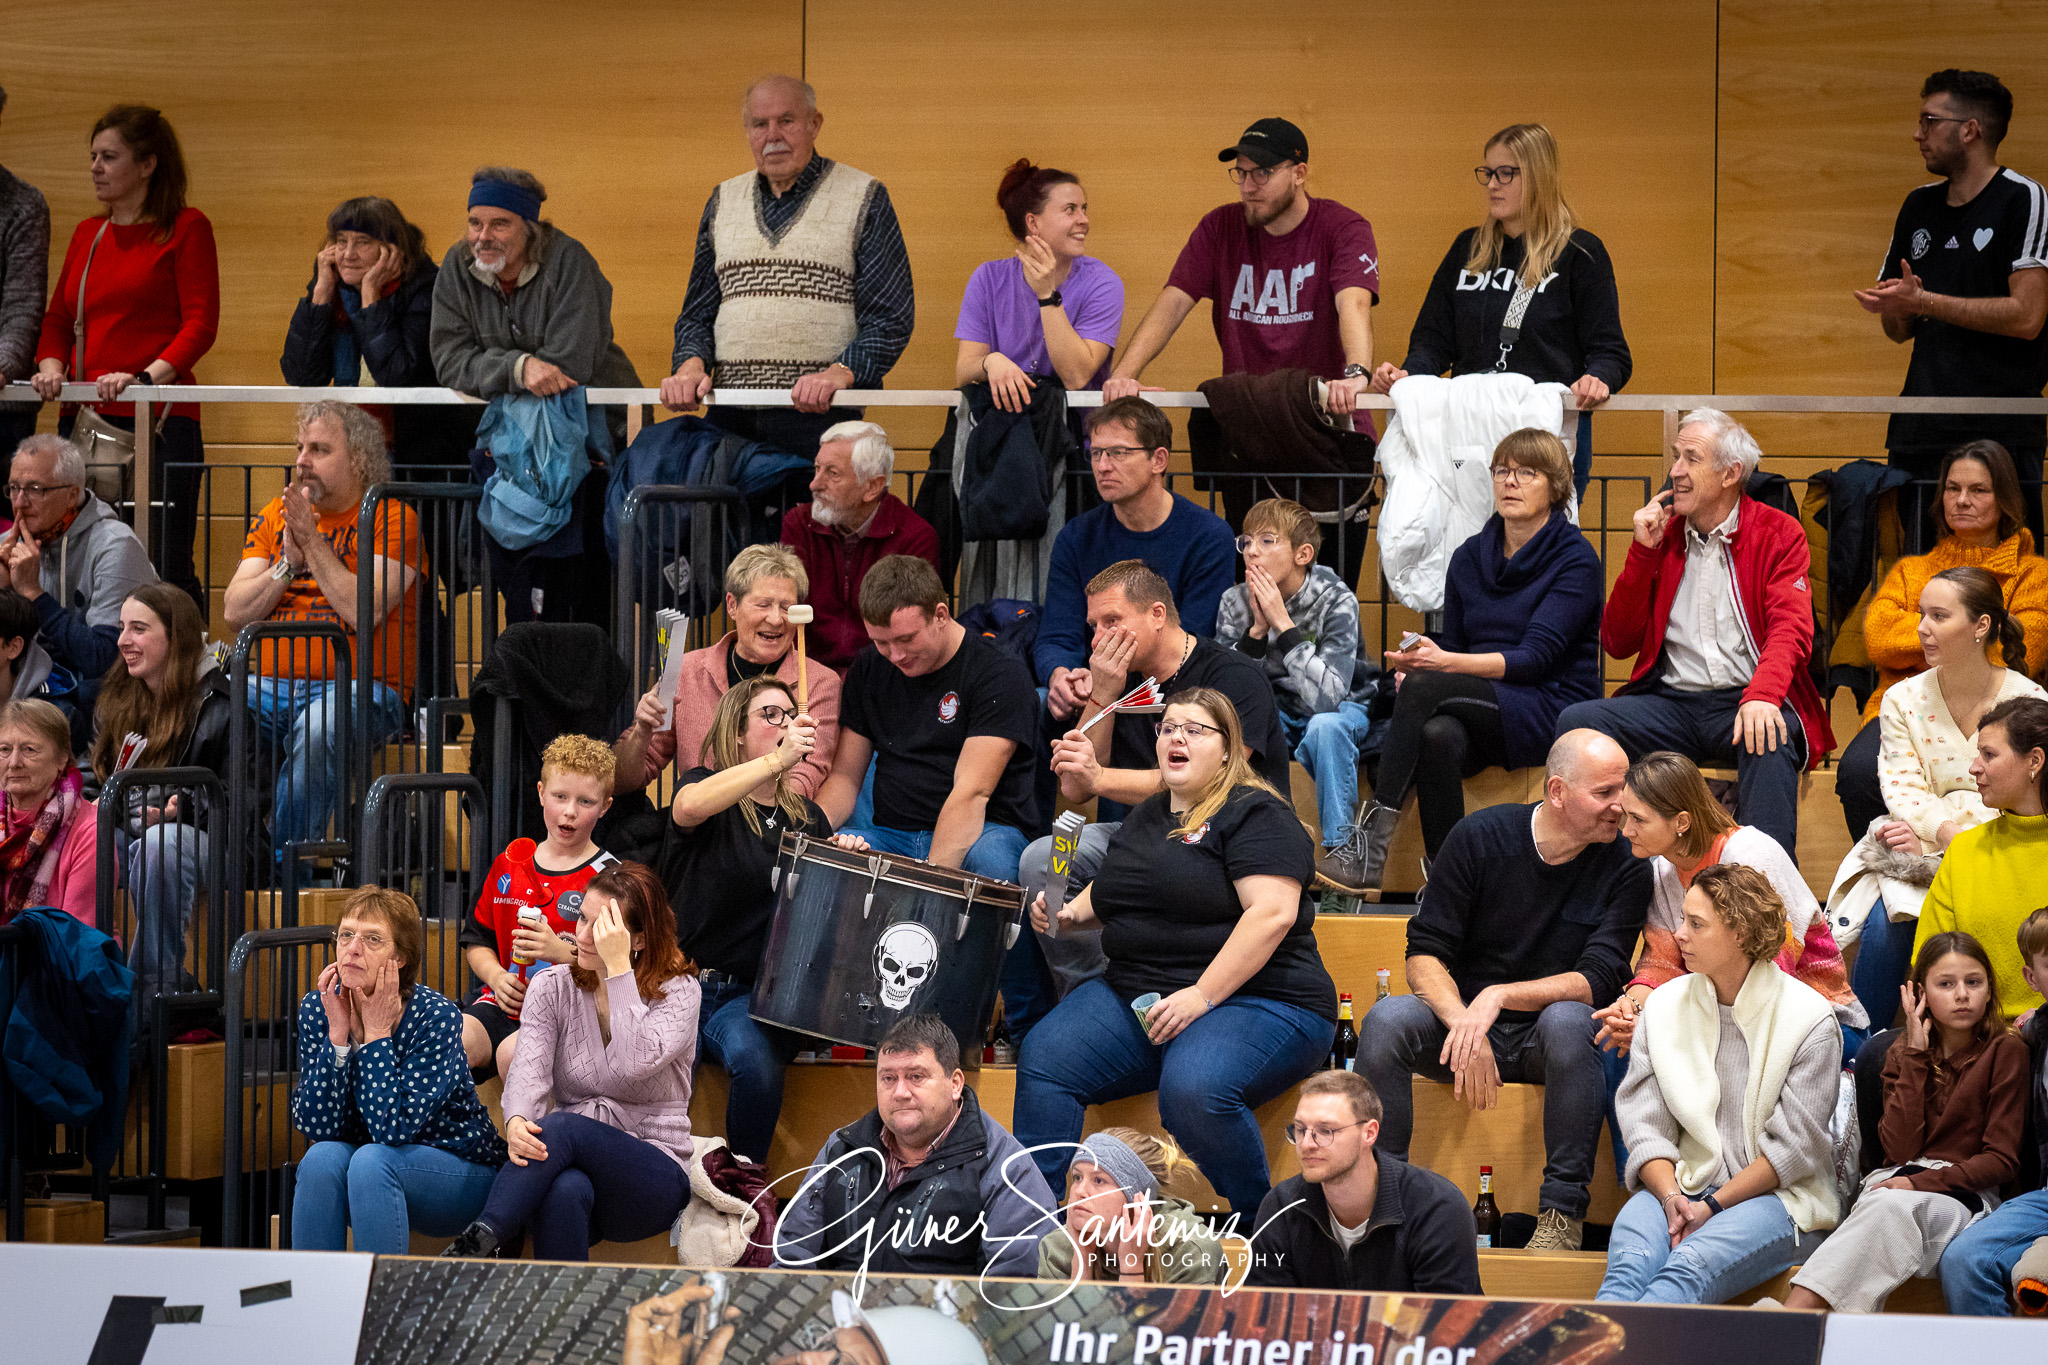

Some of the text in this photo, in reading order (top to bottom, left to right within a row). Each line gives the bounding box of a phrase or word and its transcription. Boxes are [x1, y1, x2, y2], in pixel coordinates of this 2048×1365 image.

[1228, 309, 1241, 321] ALL
[1242, 311, 1272, 325] AICAN
[1050, 1322, 1477, 1365] Ihr Partner in der
